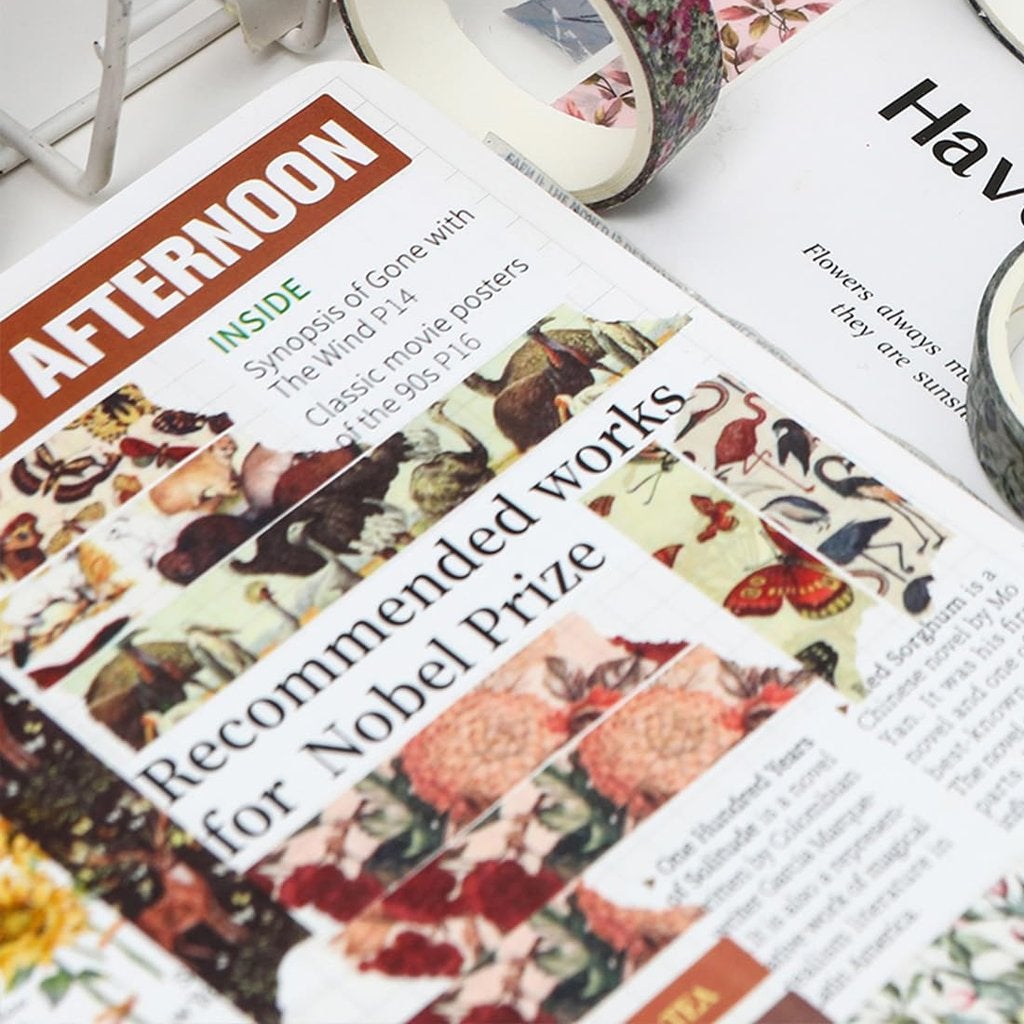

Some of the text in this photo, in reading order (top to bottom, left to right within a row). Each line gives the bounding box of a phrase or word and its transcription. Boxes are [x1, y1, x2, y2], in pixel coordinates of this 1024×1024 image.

[9, 119, 380, 400] AFTERNOON
[207, 276, 312, 355] INSIDE
[243, 205, 476, 381] Synopsis of Gone with
[801, 243, 875, 302] Flowers
[876, 304, 943, 357] always
[267, 287, 419, 400] The Wind P14
[304, 256, 531, 428] Classic movie posters
[334, 332, 483, 450] of the 90s P16
[830, 302, 875, 339] they
[877, 341, 912, 368] are
[136, 379, 688, 805] Recommended works
[886, 594, 968, 667] Sorghum
[965, 579, 985, 598] is
[982, 569, 998, 583] a
[200, 536, 608, 857] for Nobel Prize
[857, 583, 1021, 731] Chinese novel by Mo
[904, 715, 954, 766] novel
[951, 684, 989, 720] and
[984, 654, 1021, 689] one
[919, 690, 945, 710] It
[940, 658, 978, 691] was
[970, 634, 1006, 664] his
[656, 736, 816, 876] One Hundred Years
[947, 764, 983, 797] The
[685, 823, 760, 888] Solitude
